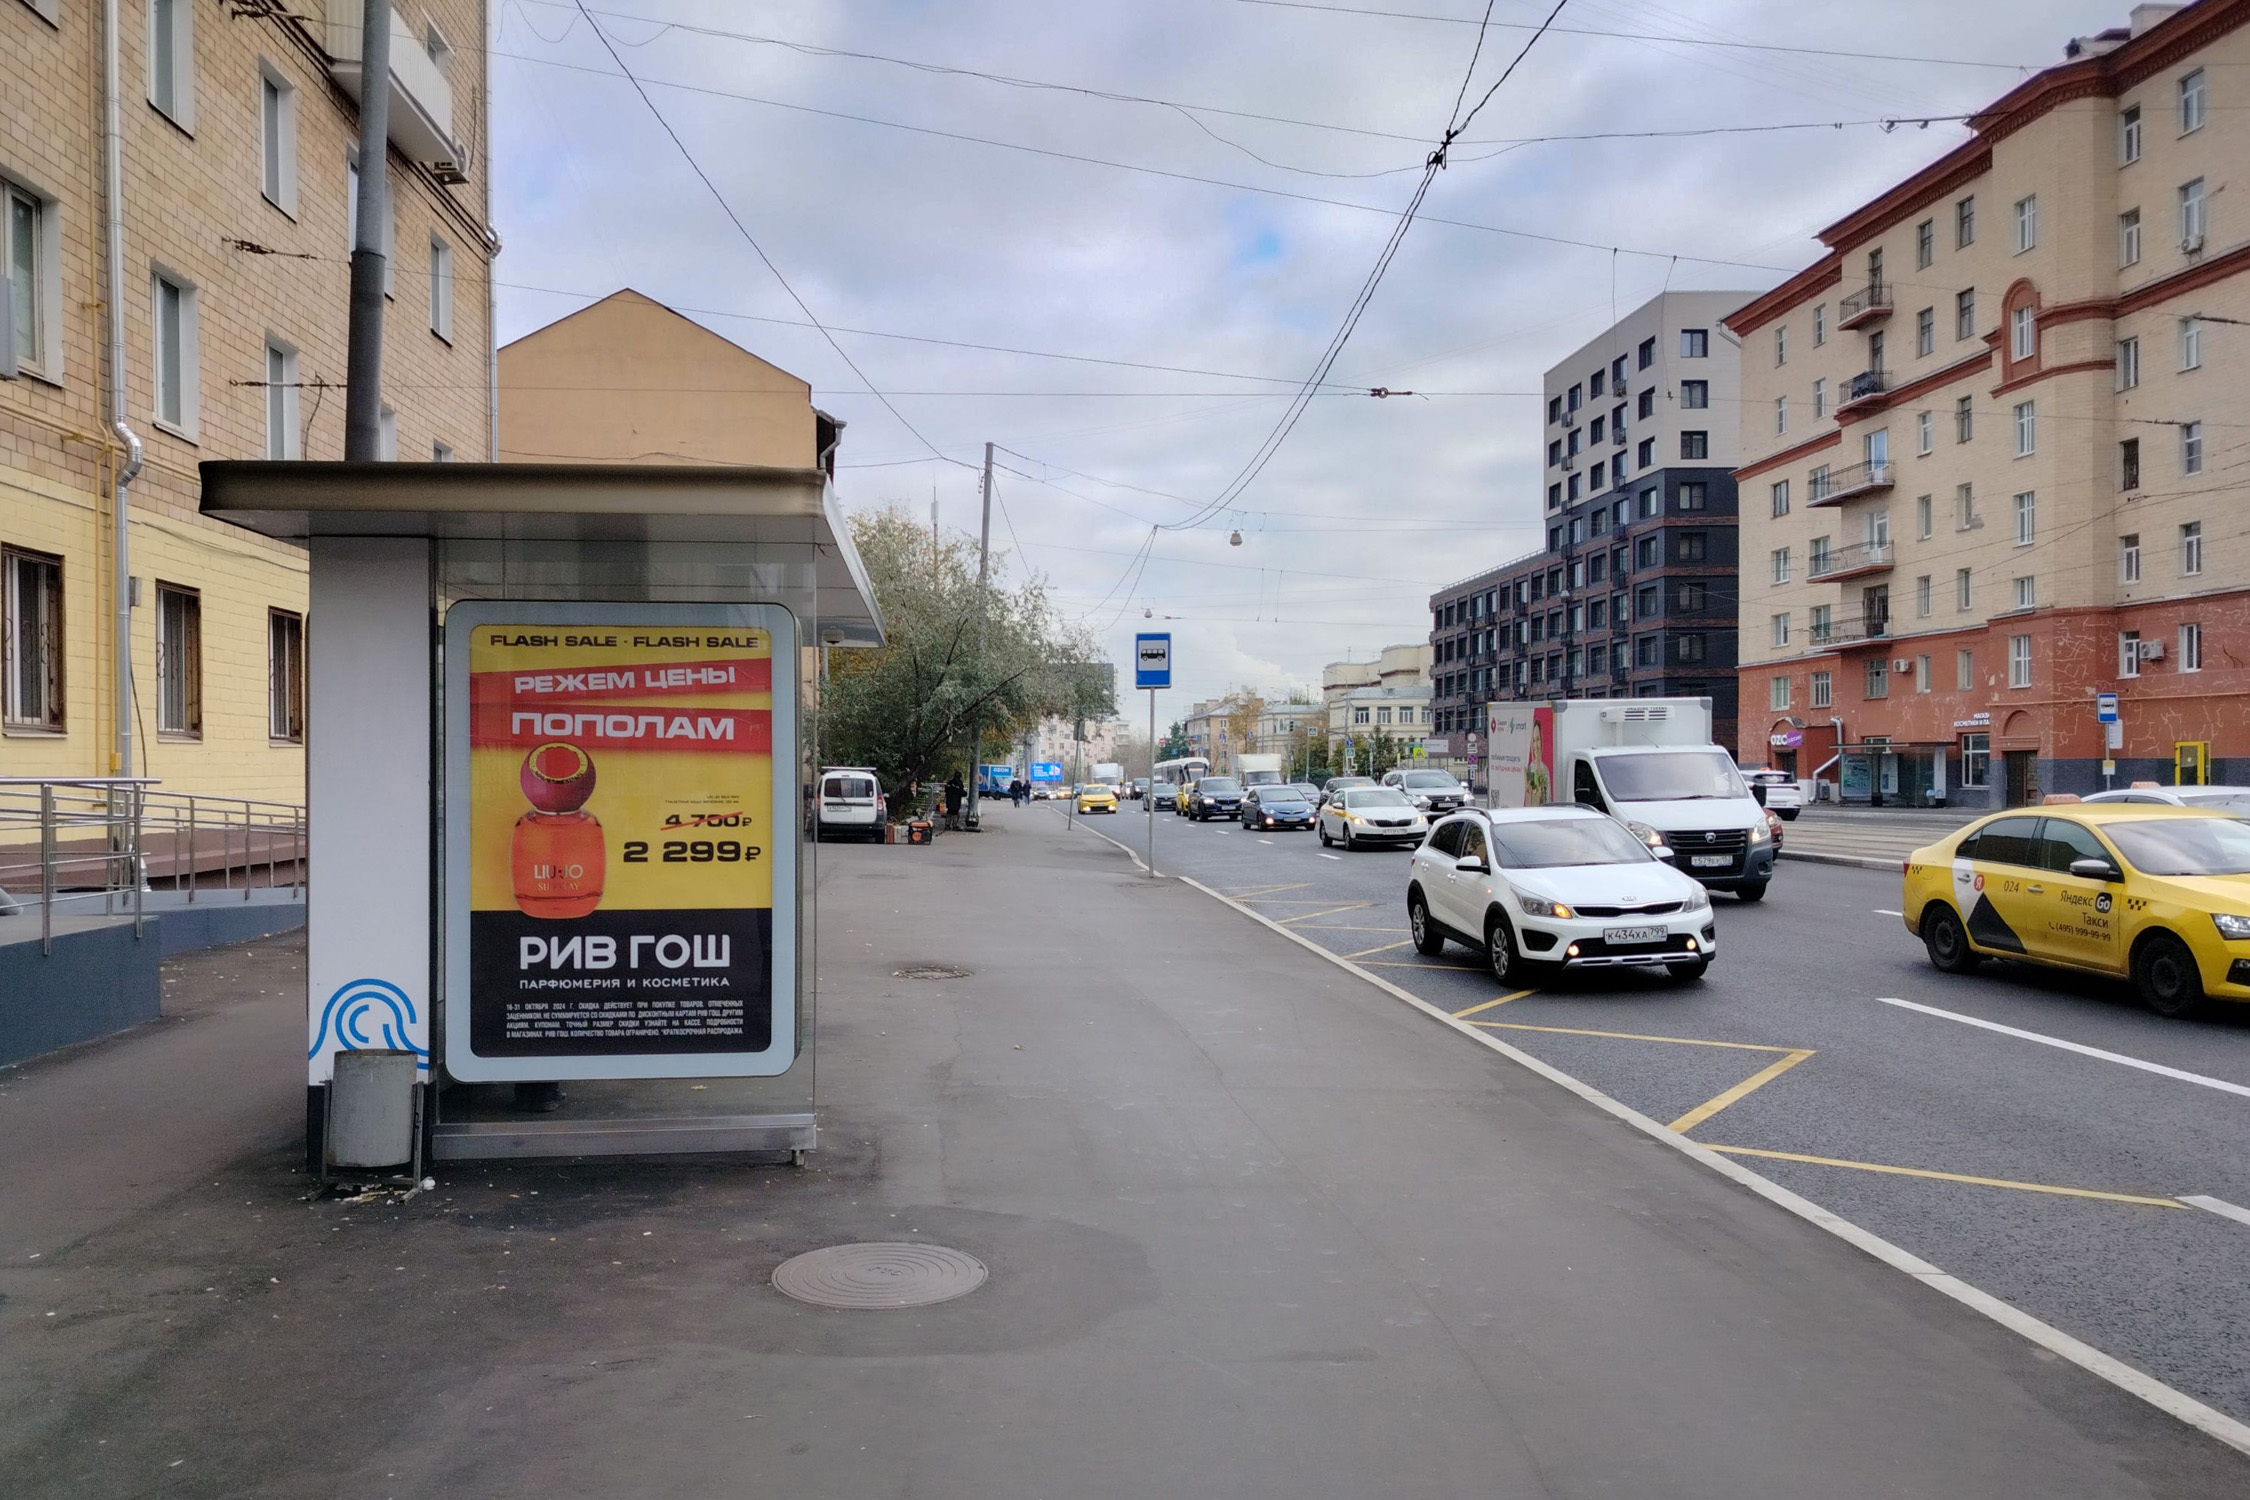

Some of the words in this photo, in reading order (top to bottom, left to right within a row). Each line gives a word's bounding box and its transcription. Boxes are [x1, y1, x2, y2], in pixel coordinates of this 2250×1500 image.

[490, 635, 558, 647] FLASH
[565, 635, 617, 647] SALE
[633, 636, 700, 648] FLASH
[706, 636, 758, 648] SALE
[514, 670, 636, 694] РЕЖЕМ
[645, 666, 736, 690] ЦЕНЫ
[512, 712, 735, 740] ПОПОЛАМ
[665, 814, 682, 826] 4
[623, 841, 648, 862] 2
[2004, 880, 2019, 893] 024
[2060, 890, 2094, 907] Яндекс
[2096, 896, 2110, 910] Go
[2082, 912, 2108, 929] Такси
[2056, 922, 2074, 934] (495)
[2075, 927, 2111, 942] 999-99-99
[520, 936, 617, 970] РИВ
[630, 934, 730, 969] ГОШ
[520, 978, 620, 990] ПАРФЮМЕРИЯ
[627, 978, 636, 988] И
[642, 977, 730, 988] КОСМЕТИКА
[604, 1001, 632, 1010] ДЕЙСТВУЕТ
